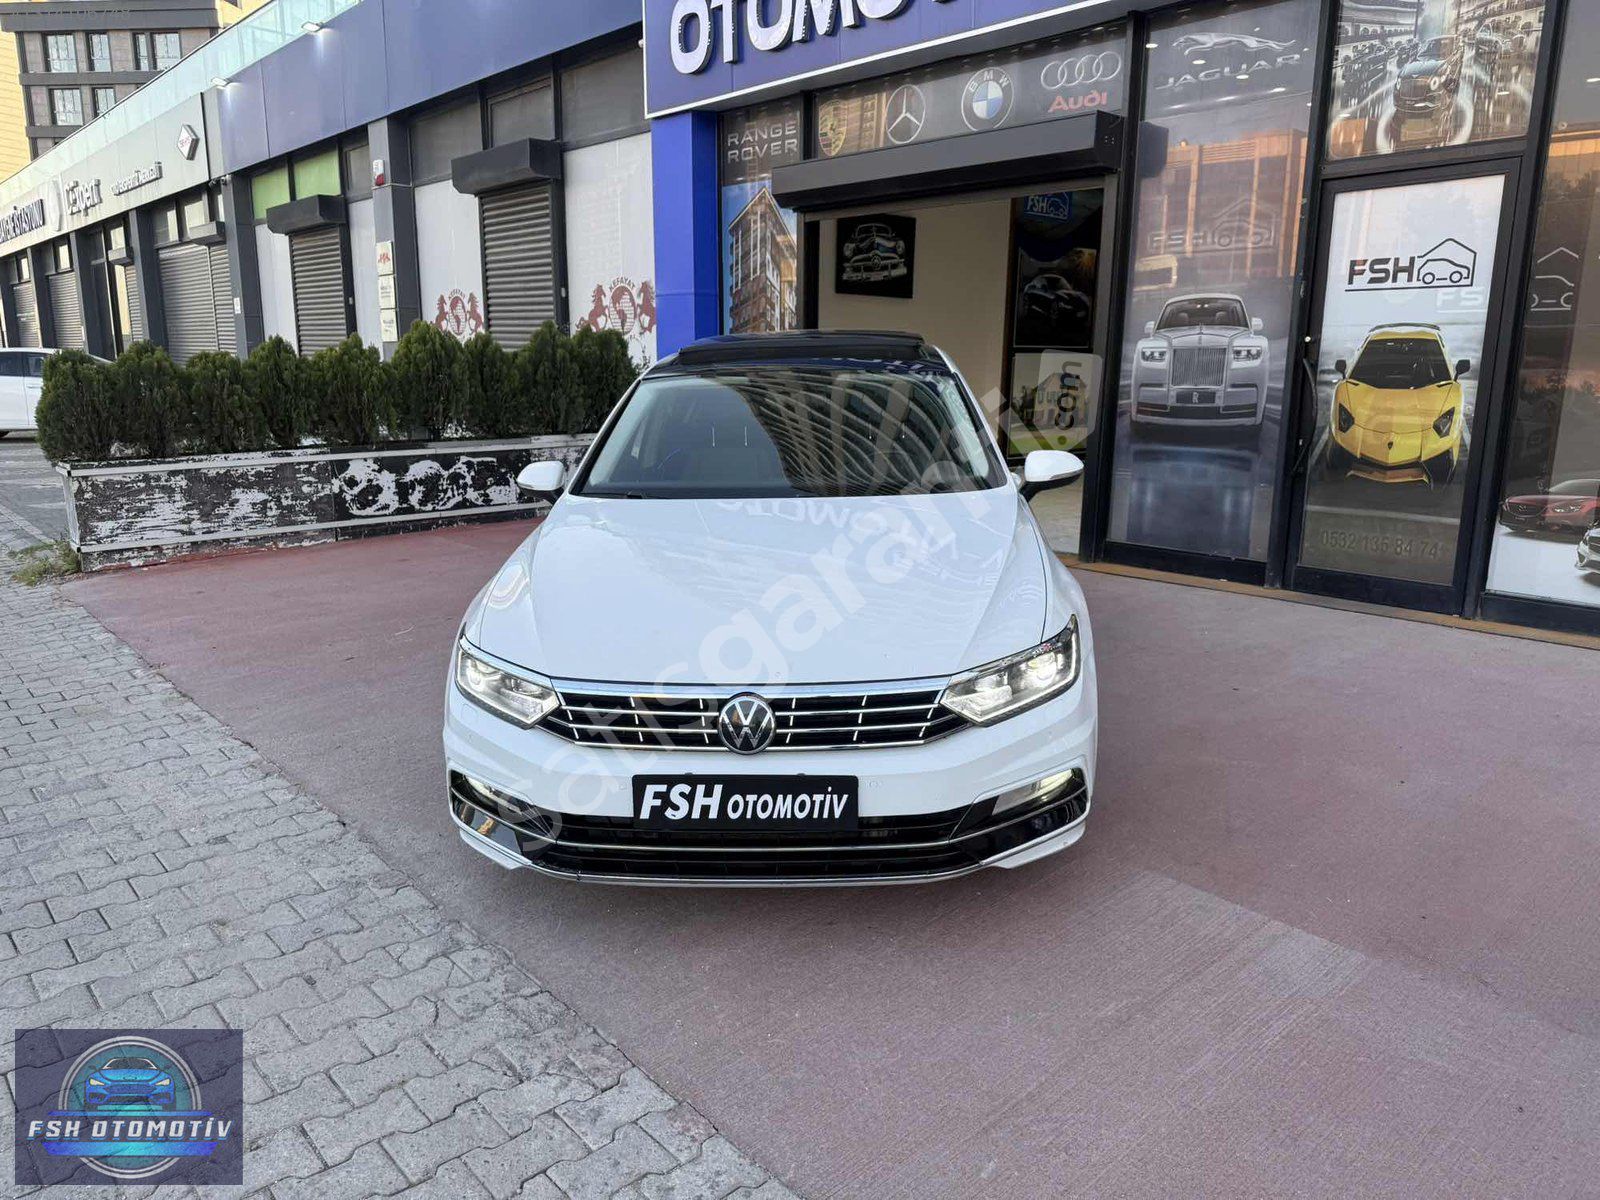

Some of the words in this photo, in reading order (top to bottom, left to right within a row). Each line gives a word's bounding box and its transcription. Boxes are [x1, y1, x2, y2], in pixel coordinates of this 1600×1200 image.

[727, 119, 797, 147] RANGE
[727, 138, 799, 165] ROVER
[1347, 256, 1416, 286] FSH
[1321, 529, 1356, 550] 0532
[640, 783, 723, 820] FSH
[727, 786, 849, 819] OTOMOTİV
